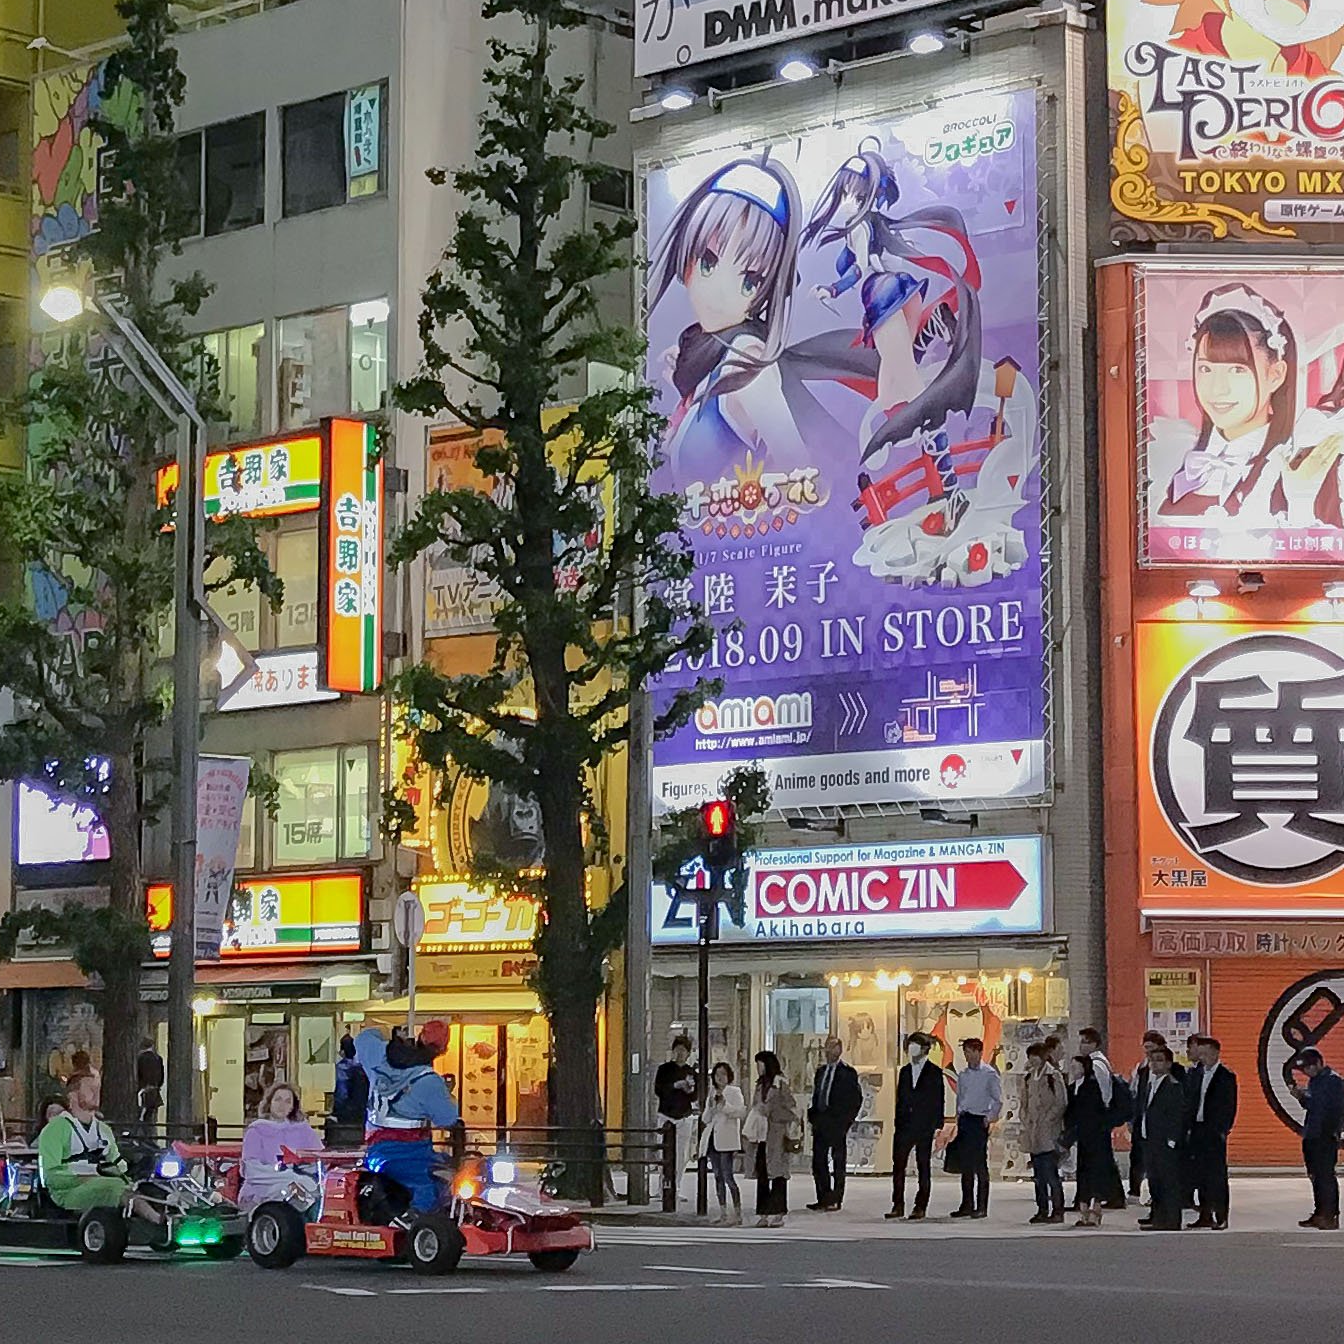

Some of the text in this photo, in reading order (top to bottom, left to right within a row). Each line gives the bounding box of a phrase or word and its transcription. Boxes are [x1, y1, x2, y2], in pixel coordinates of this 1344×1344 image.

[1179, 170, 1287, 195] TOKYO
[337, 495, 360, 614] 吉野家
[722, 544, 757, 562] Scale
[760, 540, 803, 559] Figure
[820, 616, 865, 659] IN
[883, 599, 1025, 654] STORE
[696, 692, 813, 735] amiami
[774, 772, 818, 791] Anime
[820, 770, 862, 790] goods
[864, 768, 889, 786] and
[891, 769, 931, 784] more
[815, 849, 855, 866] Support
[857, 848, 872, 862] for
[873, 846, 926, 864] Magazine
[928, 845, 937, 858] &
[759, 866, 956, 915] COMIC ZIN
[1152, 869, 1208, 888] 大黒屋
[755, 918, 866, 938] Akihabara
